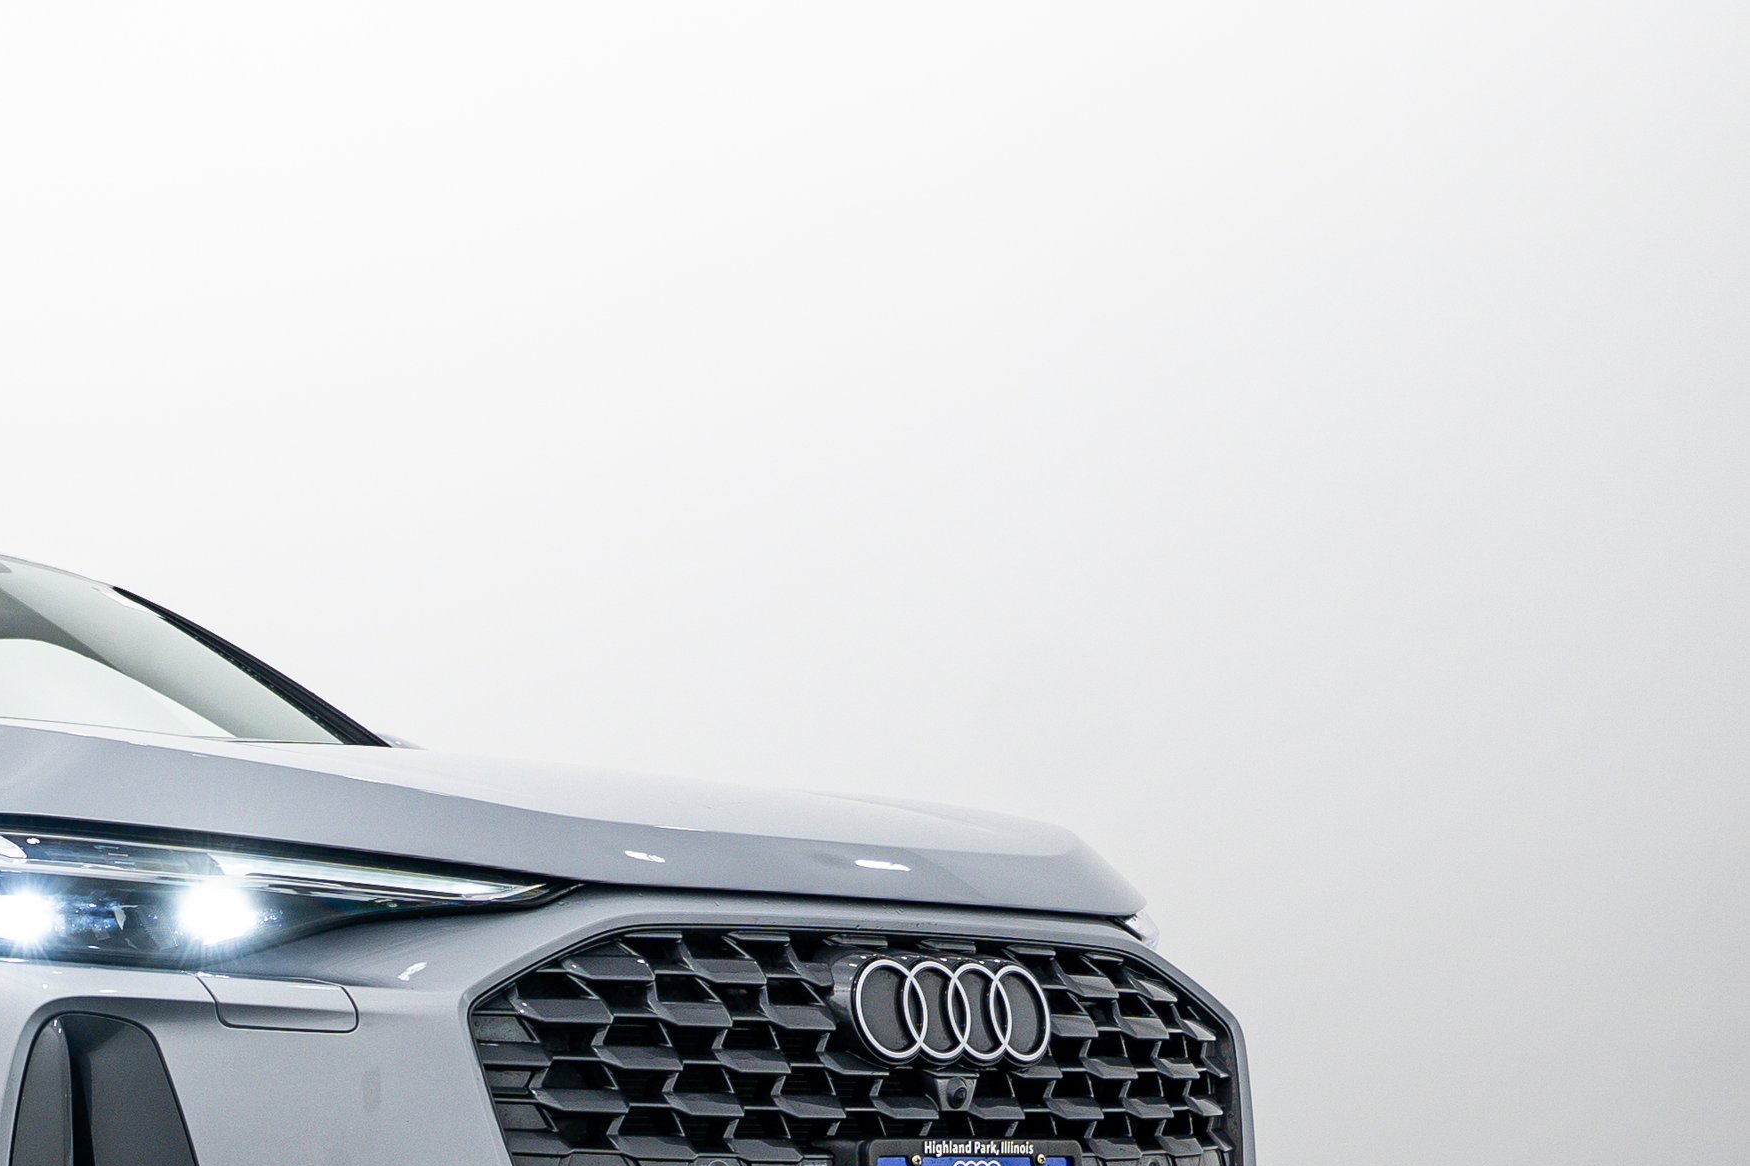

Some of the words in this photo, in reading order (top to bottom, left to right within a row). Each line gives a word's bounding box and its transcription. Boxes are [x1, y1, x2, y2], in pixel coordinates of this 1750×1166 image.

[924, 1140, 972, 1157] Highland
[973, 1140, 1000, 1155] Park,
[1001, 1140, 1034, 1155] Illinois
